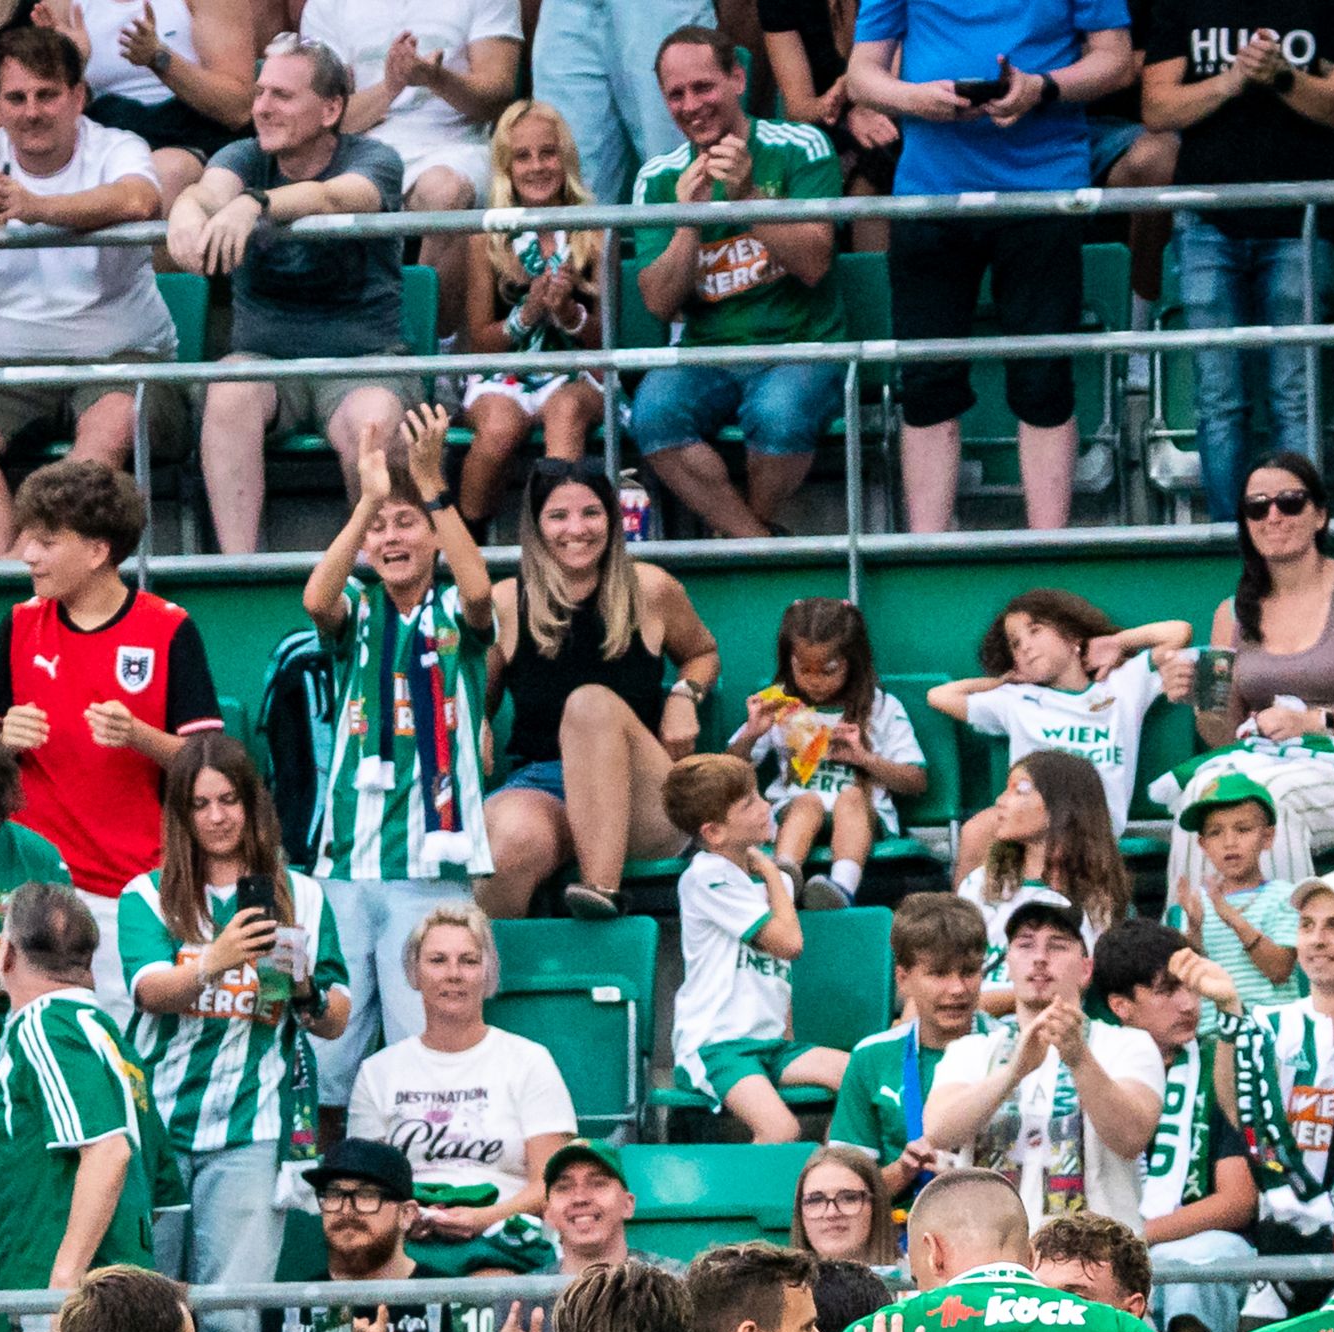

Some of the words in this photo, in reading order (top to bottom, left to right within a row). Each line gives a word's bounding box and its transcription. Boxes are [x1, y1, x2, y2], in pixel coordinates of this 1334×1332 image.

[1042, 726, 1110, 743] WIEN
[390, 1119, 503, 1165] Place
[983, 1269, 1017, 1279] SCR
[984, 1294, 1088, 1327] köck
